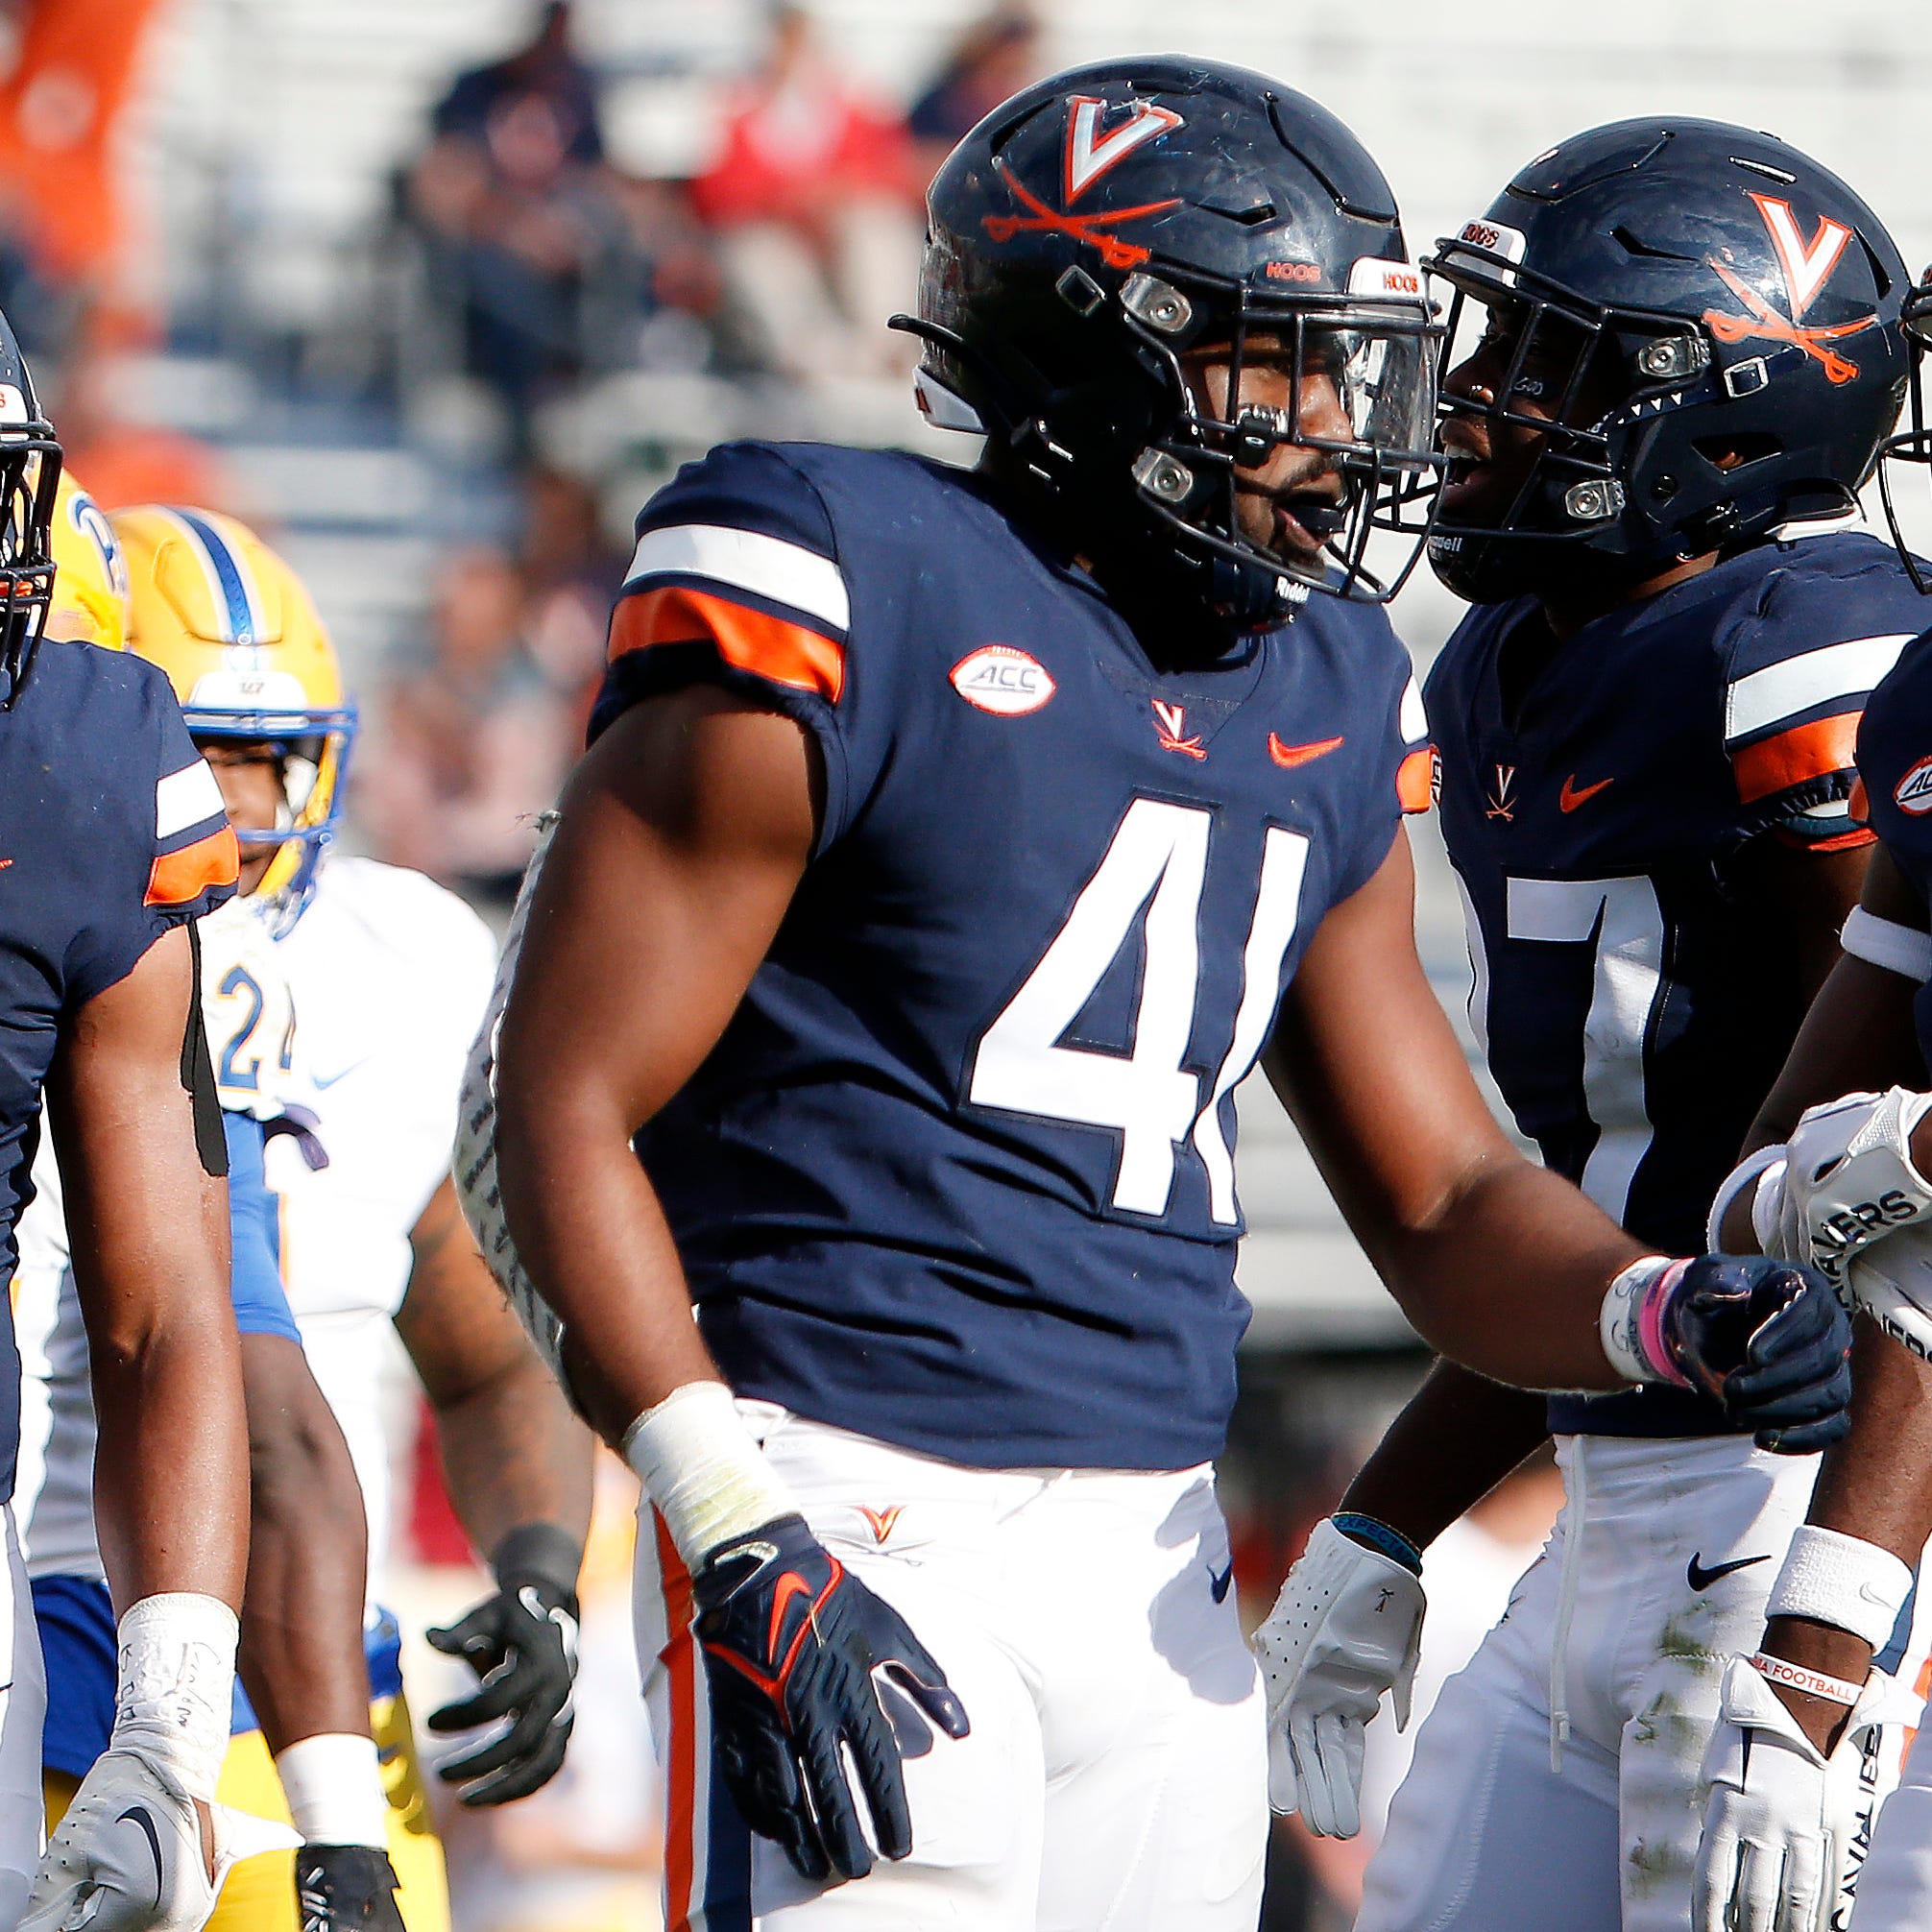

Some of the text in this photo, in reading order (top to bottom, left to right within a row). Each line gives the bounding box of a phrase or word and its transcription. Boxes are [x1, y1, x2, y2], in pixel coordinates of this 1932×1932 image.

[1266, 261, 1321, 282] HOOS
[1383, 273, 1418, 293] HOOS
[968, 664, 1037, 688] ACC
[1903, 769, 1932, 796] AC
[970, 796, 1310, 1226] 41
[1772, 1664, 1851, 1701] FOOTBALL
